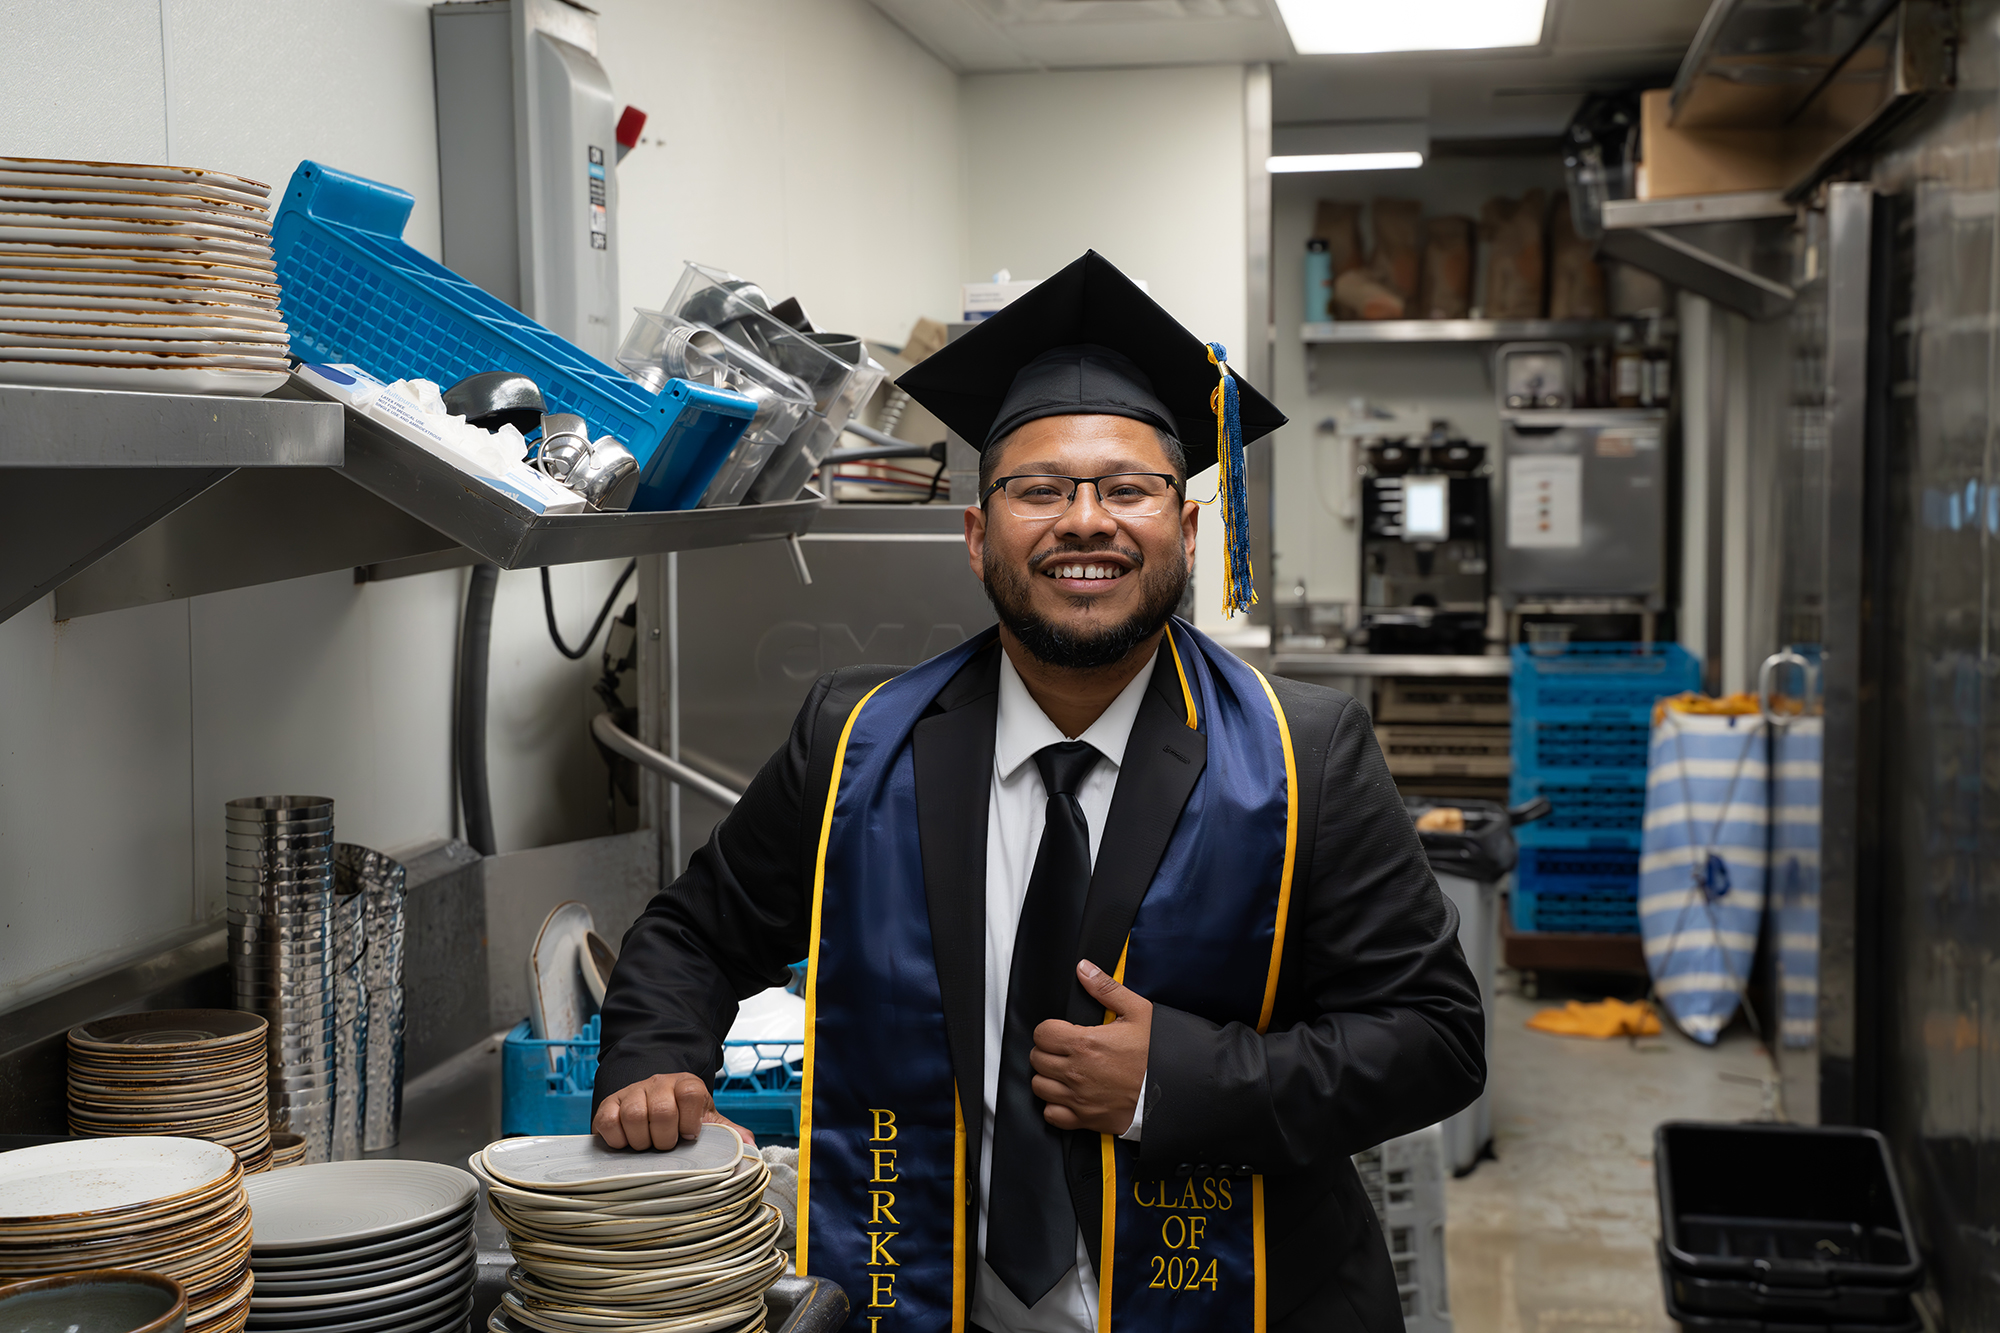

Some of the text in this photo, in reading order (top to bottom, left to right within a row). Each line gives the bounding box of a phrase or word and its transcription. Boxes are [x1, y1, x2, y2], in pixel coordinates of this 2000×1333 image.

[1133, 1176, 1233, 1211] CLASS
[1161, 1214, 1207, 1250] OF
[1148, 1255, 1219, 1292] 2024
